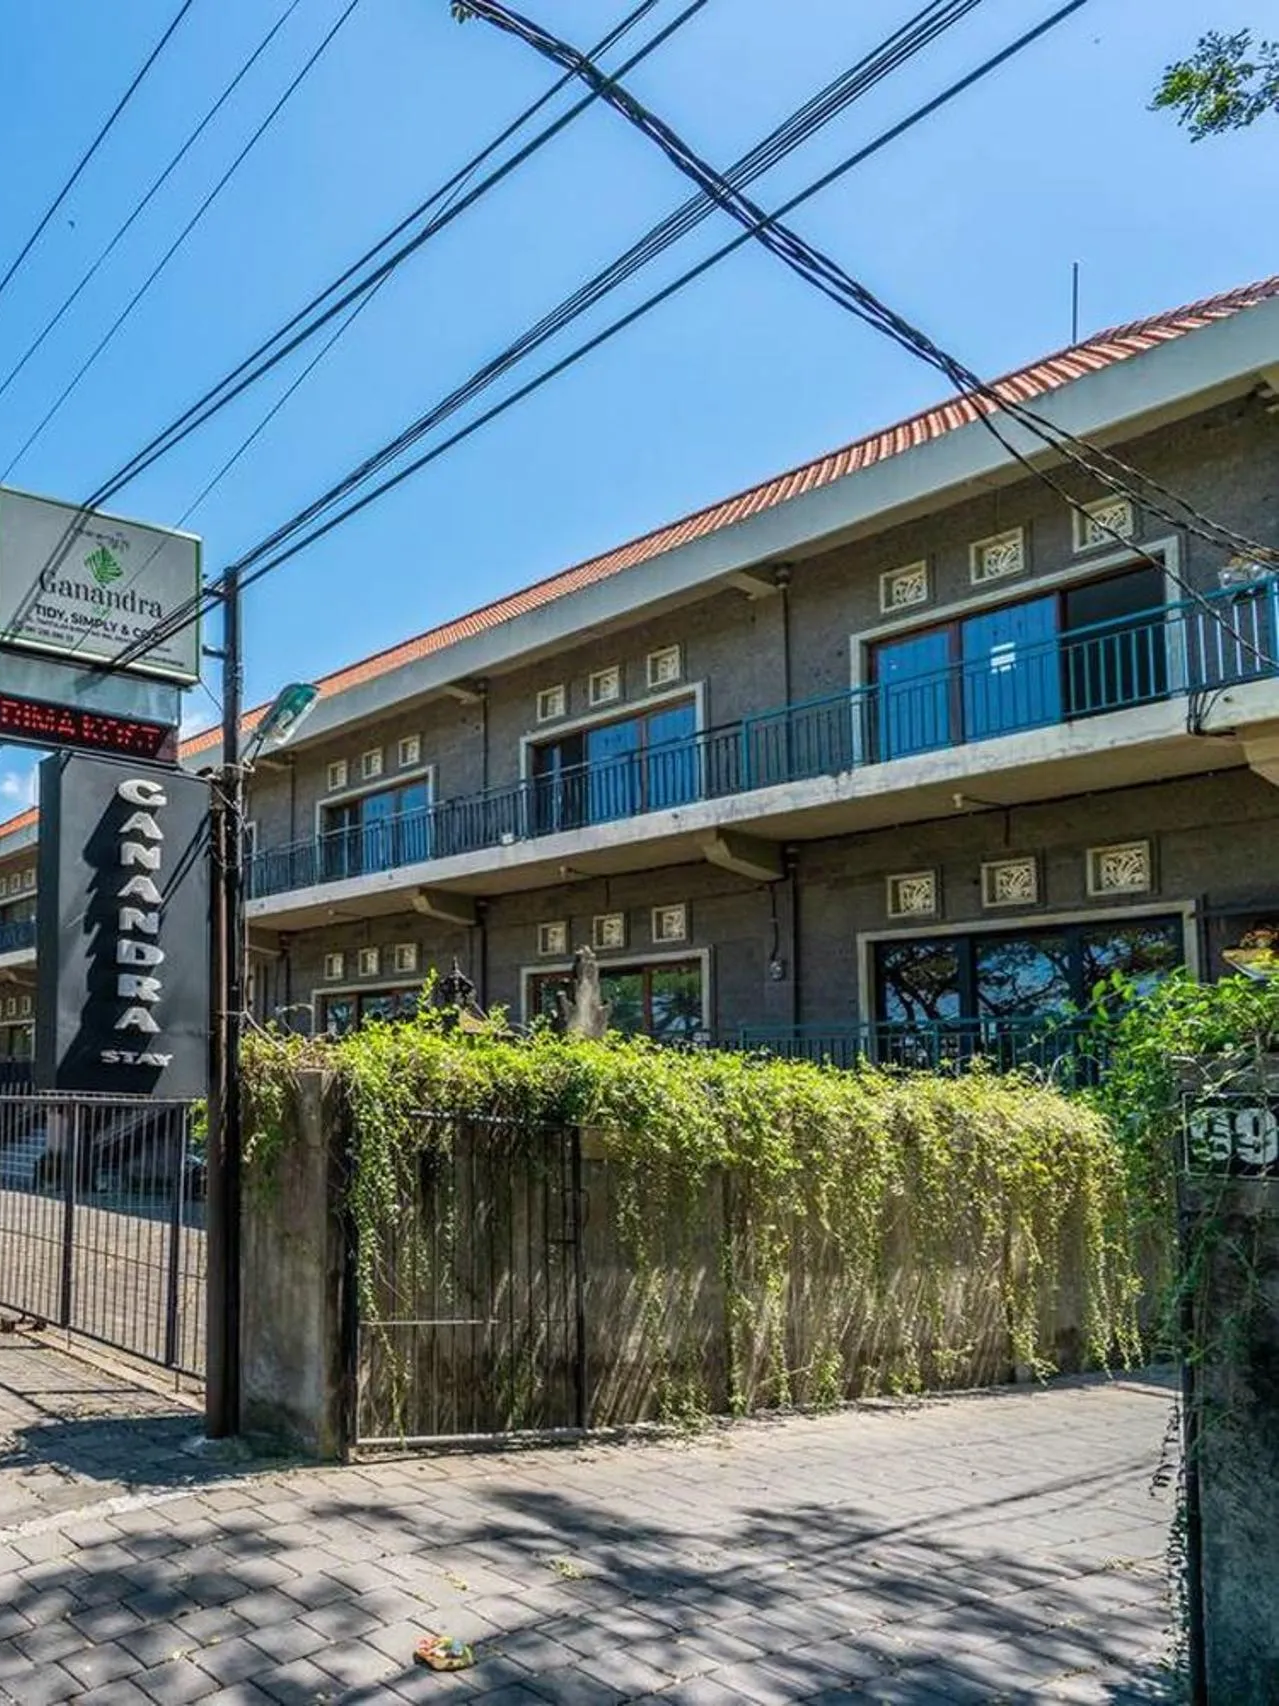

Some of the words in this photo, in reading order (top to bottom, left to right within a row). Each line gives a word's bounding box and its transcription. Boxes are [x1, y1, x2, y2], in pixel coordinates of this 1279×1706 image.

[39, 570, 163, 618] Ganandra
[35, 603, 68, 622] TIDY,
[70, 612, 118, 632] SIMPLY
[120, 624, 130, 636] &
[115, 778, 168, 1033] GANANDRA
[100, 1050, 173, 1067] STAY
